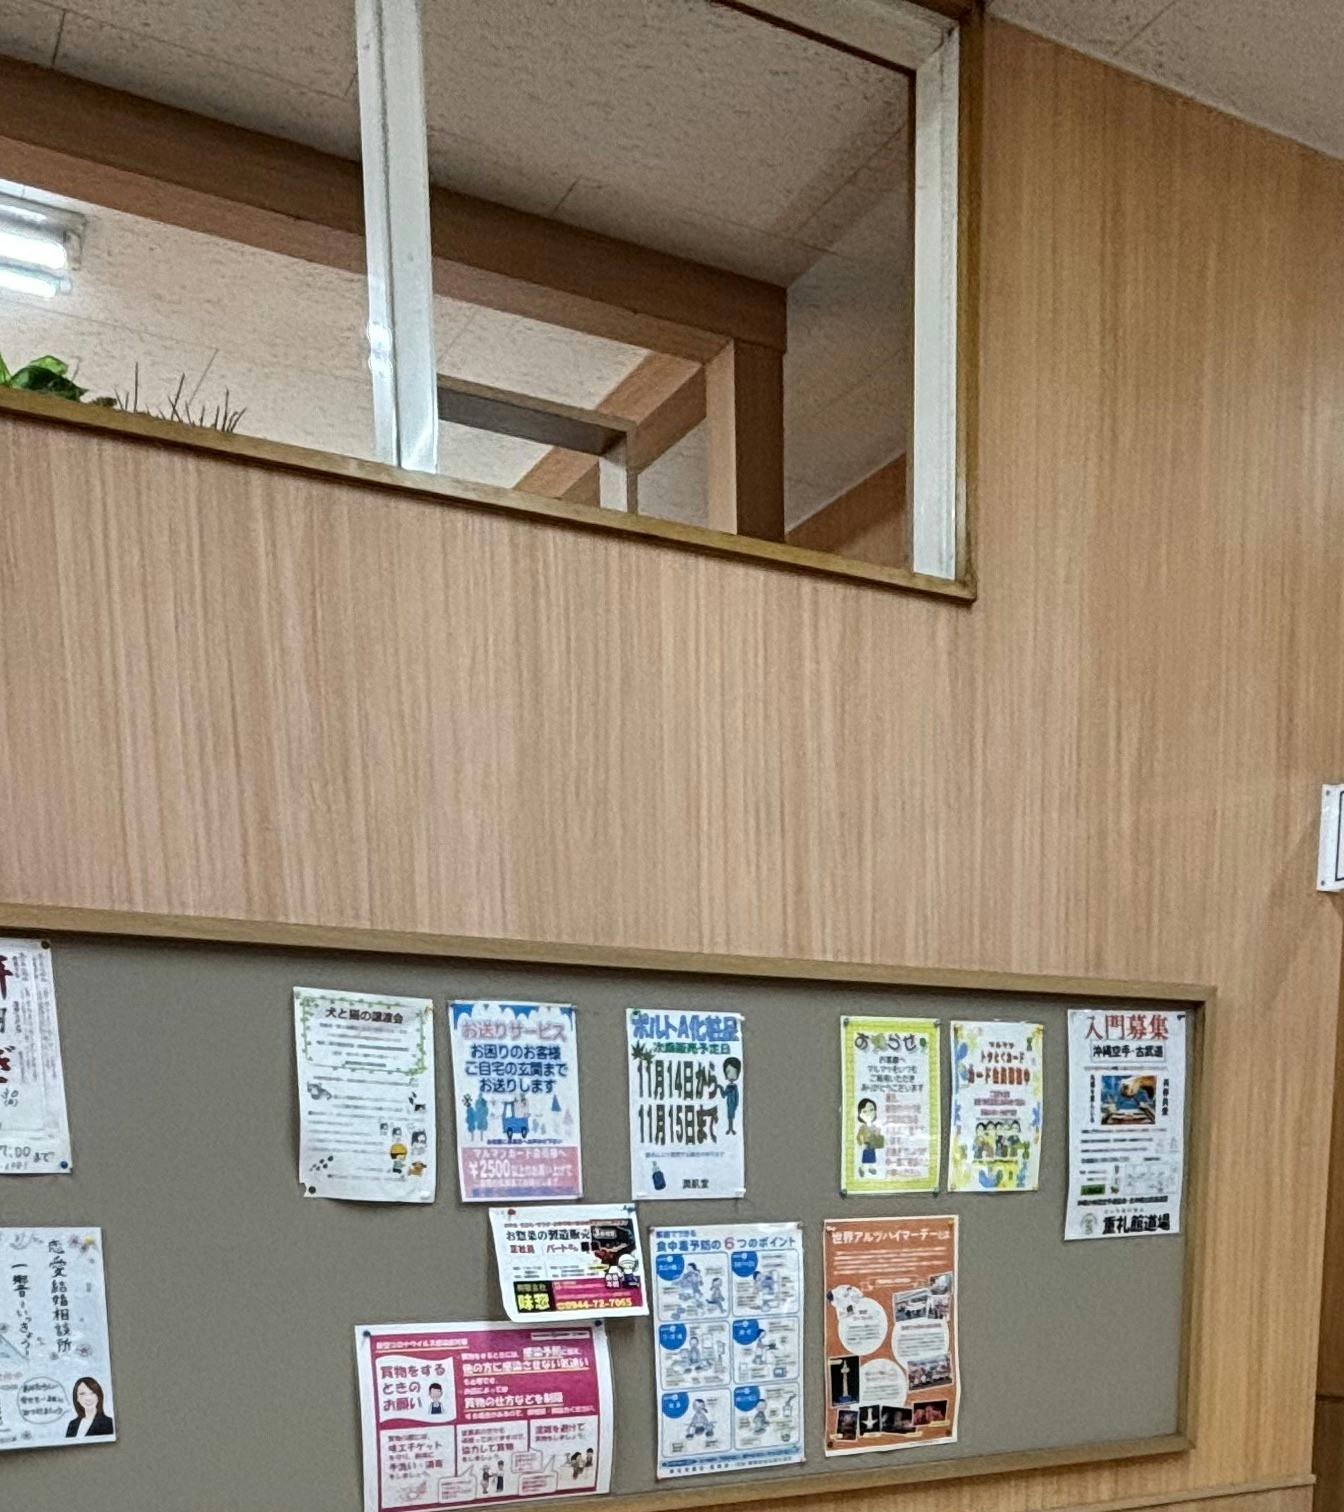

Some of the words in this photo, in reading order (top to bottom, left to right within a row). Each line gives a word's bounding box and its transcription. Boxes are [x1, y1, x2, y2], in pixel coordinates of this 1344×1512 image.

[462, 1020, 567, 1041] お送りサービス
[1085, 1014, 1169, 1040] 入門募集
[470, 1044, 561, 1059] お困りのお客様
[465, 1061, 568, 1077] ご自宅の玄関まで
[480, 1079, 555, 1094] お送りします
[638, 1060, 718, 1100] 11月14日から
[639, 1104, 719, 1145] 11月15日まで
[48, 1239, 72, 1353] 恋愛結婚相談所
[380, 1364, 446, 1378] 買物をする
[382, 1382, 421, 1395] ときの
[383, 1398, 422, 1412] お願い
